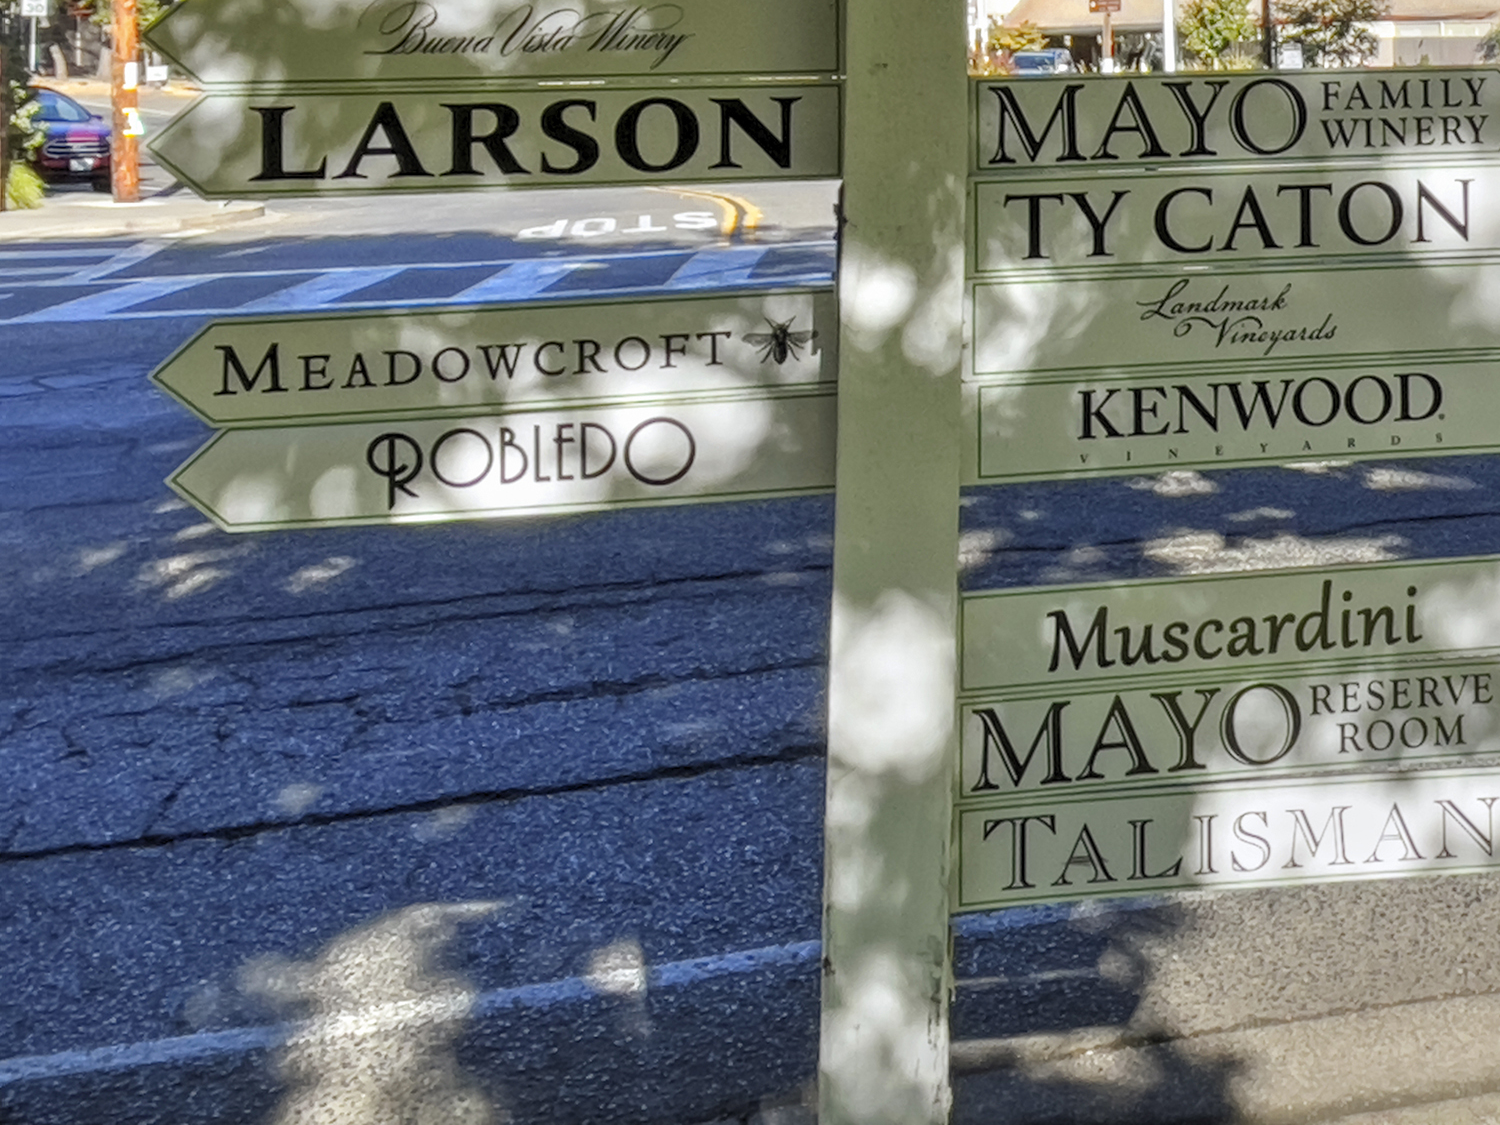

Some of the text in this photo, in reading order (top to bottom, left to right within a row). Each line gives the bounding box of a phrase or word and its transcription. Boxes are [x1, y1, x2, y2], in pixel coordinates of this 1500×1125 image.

[494, 4, 582, 57] Vista
[573, 4, 696, 70] Winery
[987, 77, 1309, 165] MAYO
[1320, 76, 1489, 113] FAMILY
[247, 95, 804, 183] LARSON
[1320, 114, 1491, 151] WINERY
[514, 211, 718, 240] STOP
[1003, 178, 1476, 261] TY CATON
[1136, 278, 1292, 321] Landmark
[213, 329, 733, 398] MEADOWCROFT
[1173, 313, 1338, 356] Vineyards
[365, 416, 697, 510] ROBLEDO
[1079, 432, 1443, 465] VINEYARDS
[1046, 579, 1424, 673] Muscardini
[1310, 674, 1495, 717] RESERVE
[970, 682, 1303, 794] MAYO
[1337, 714, 1467, 755] ROOM
[983, 796, 1500, 893] TALISMAN
